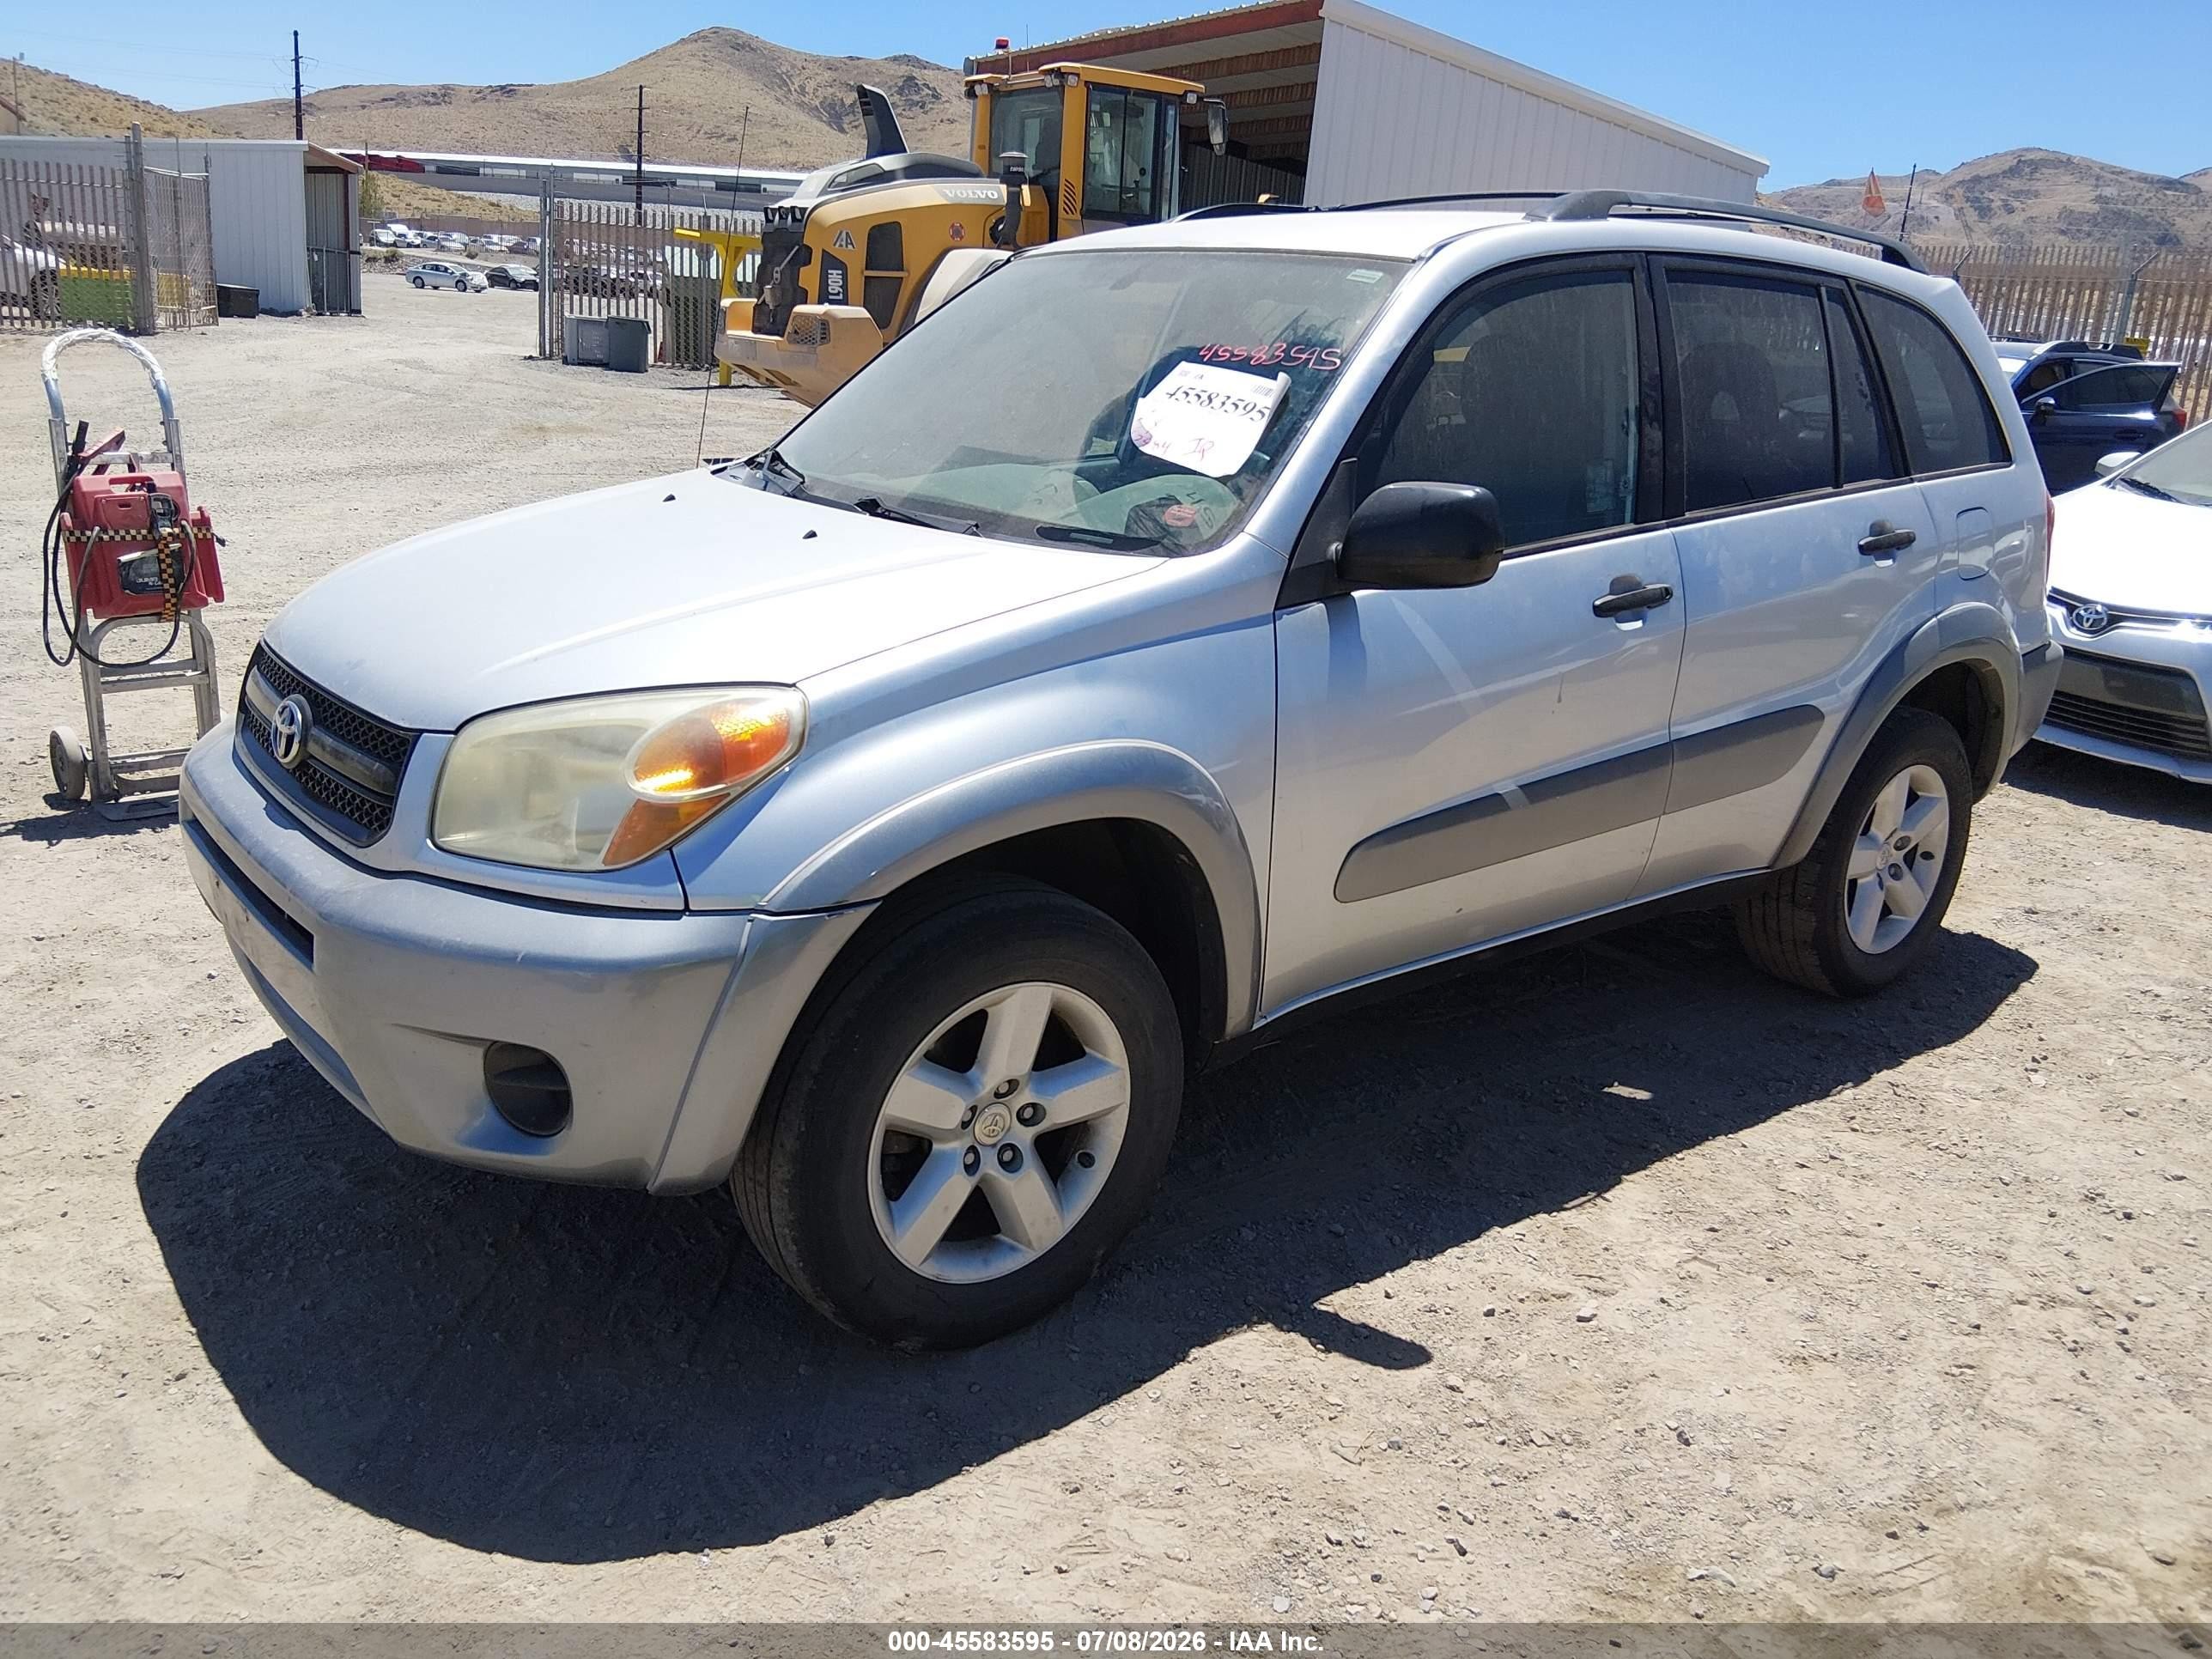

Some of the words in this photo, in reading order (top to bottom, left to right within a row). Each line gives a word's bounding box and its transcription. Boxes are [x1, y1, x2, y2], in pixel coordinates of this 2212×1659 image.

[943, 189, 999, 199] VOLVO
[827, 269, 843, 301] L90H
[1199, 343, 1341, 370] 45583595
